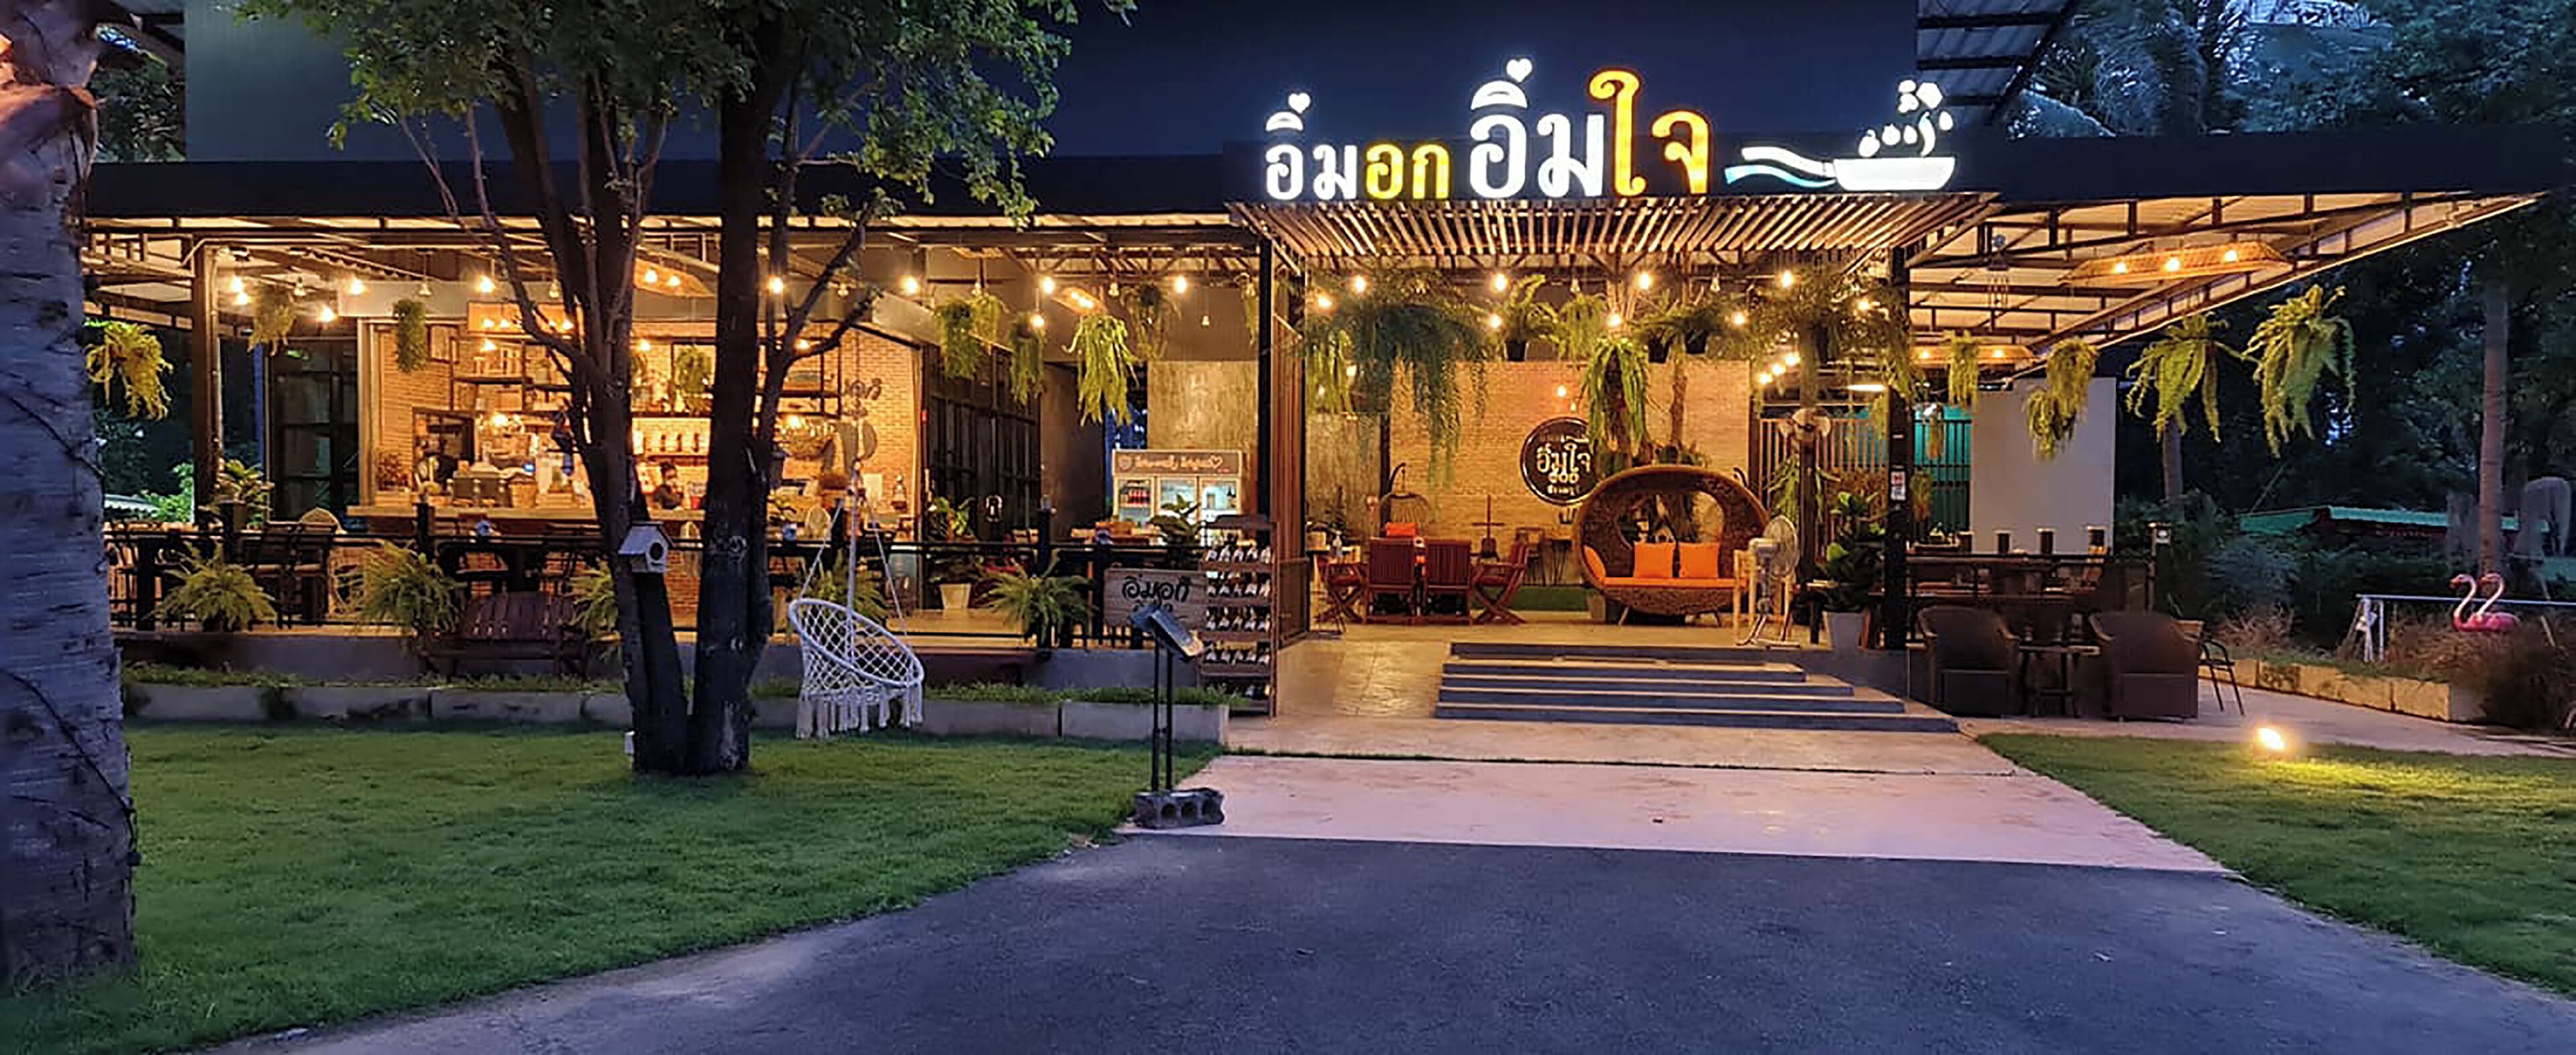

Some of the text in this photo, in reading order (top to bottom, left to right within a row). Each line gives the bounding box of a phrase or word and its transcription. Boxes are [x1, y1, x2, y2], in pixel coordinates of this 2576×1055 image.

[1265, 58, 1711, 201] อิ่มอก อิ่มใจ
